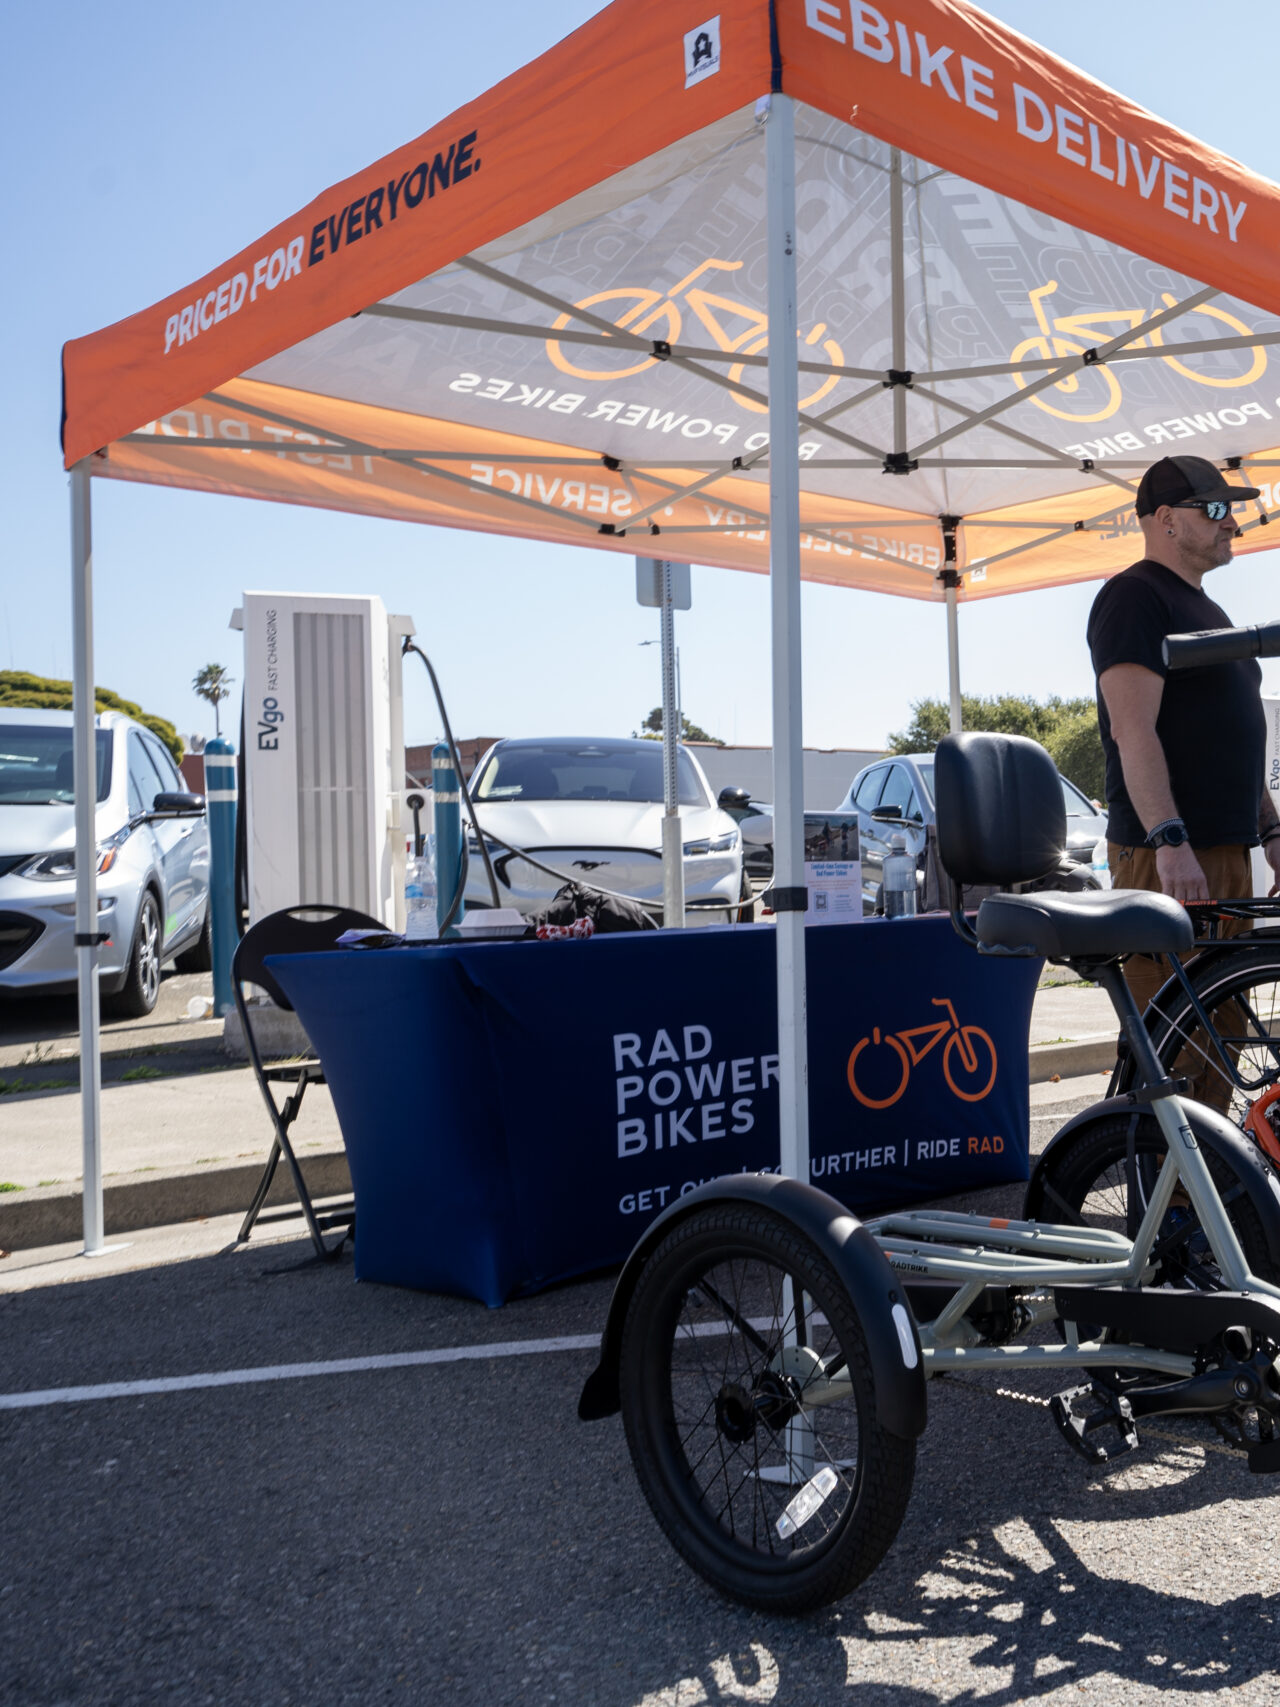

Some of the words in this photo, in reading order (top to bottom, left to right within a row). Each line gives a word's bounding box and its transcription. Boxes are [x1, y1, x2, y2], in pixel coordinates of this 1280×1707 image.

[805, 0, 999, 121] EBIKE
[1013, 82, 1247, 243] DELIVERY
[164, 272, 249, 354] PRICED
[250, 236, 305, 302] FOR
[308, 129, 482, 268] EVERYONE.
[266, 608, 278, 665] CHARGING
[267, 665, 278, 691] FAST
[257, 697, 284, 751] EVgo
[613, 1024, 713, 1073] RAD
[616, 1053, 782, 1116] POWER
[617, 1098, 755, 1159] BIKES
[618, 1186, 671, 1215] GET
[809, 1146, 897, 1178] URTHER
[917, 1138, 961, 1161] RIDE
[967, 1135, 1005, 1155] RAD
